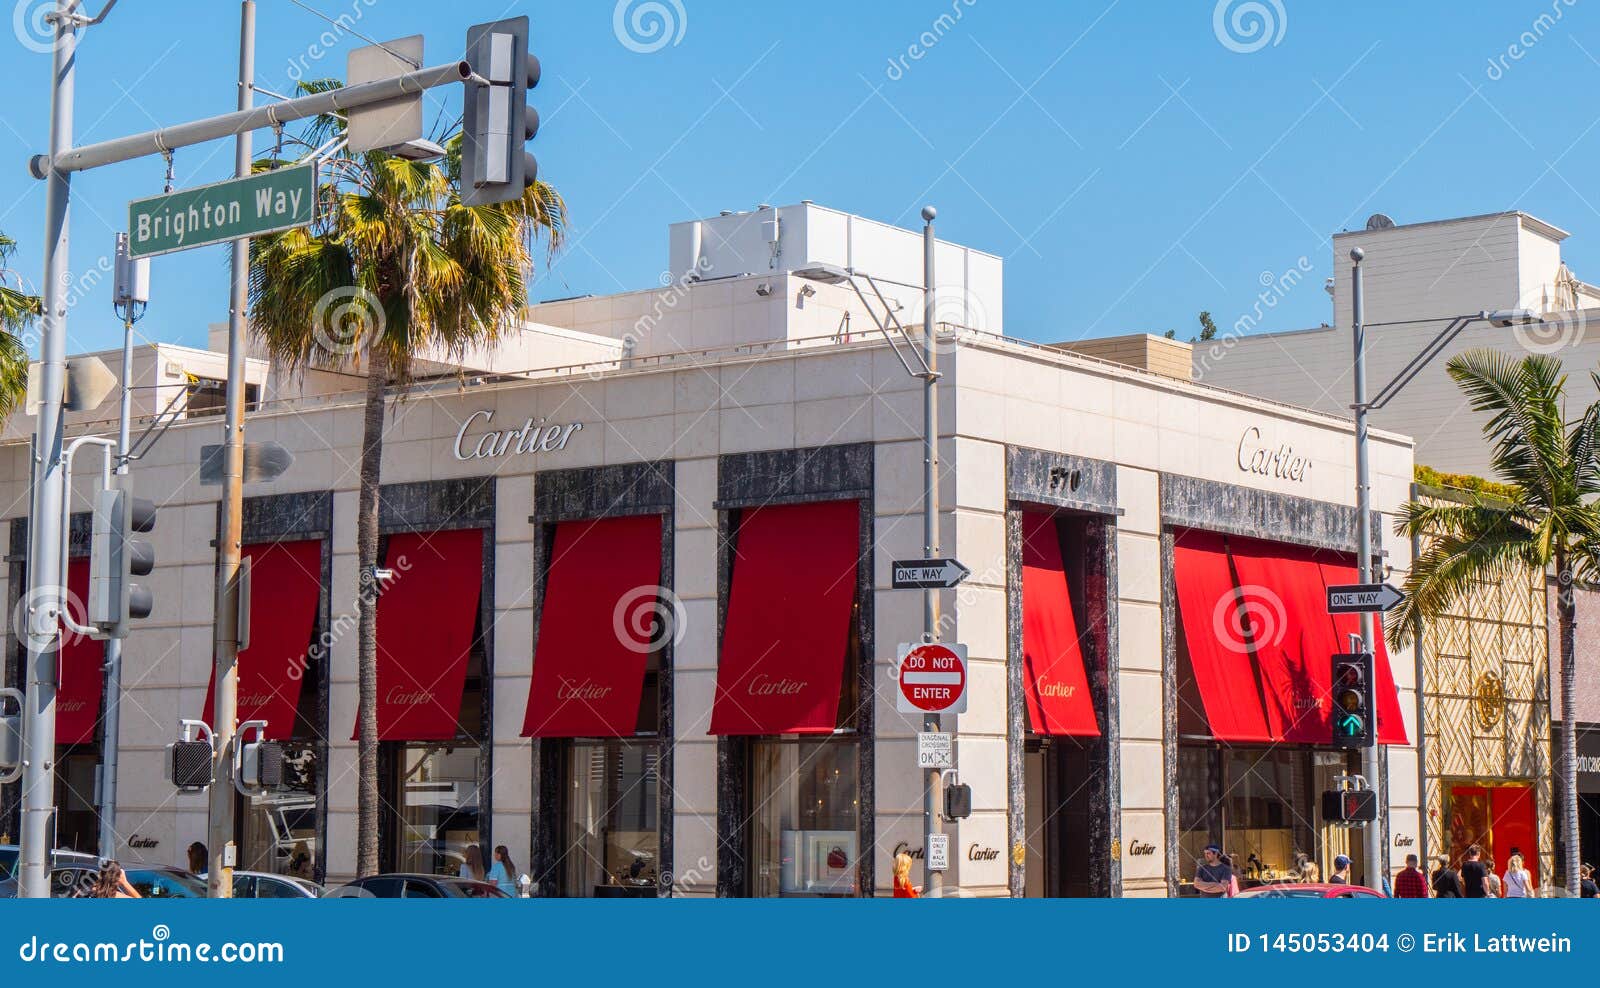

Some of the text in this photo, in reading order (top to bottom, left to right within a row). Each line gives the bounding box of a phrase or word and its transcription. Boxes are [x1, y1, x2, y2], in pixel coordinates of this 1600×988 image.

[137, 186, 303, 244] Brighton Way
[454, 410, 584, 460] Cartier
[1238, 425, 1312, 482] Cartier
[897, 568, 943, 581] ONE WAY
[1333, 593, 1378, 605] ONE WAY
[909, 657, 955, 669] DO NOT
[558, 678, 612, 699] Cartier
[748, 673, 808, 696] Cartier
[913, 687, 950, 699] ENTER
[1037, 674, 1076, 697] Cartier
[386, 684, 436, 705] Cartier
[921, 752, 934, 764] OK
[128, 834, 160, 848] Cartier
[1129, 839, 1156, 856] Cartier
[1395, 833, 1414, 847] Cartier
[968, 843, 1000, 861] Cartier
